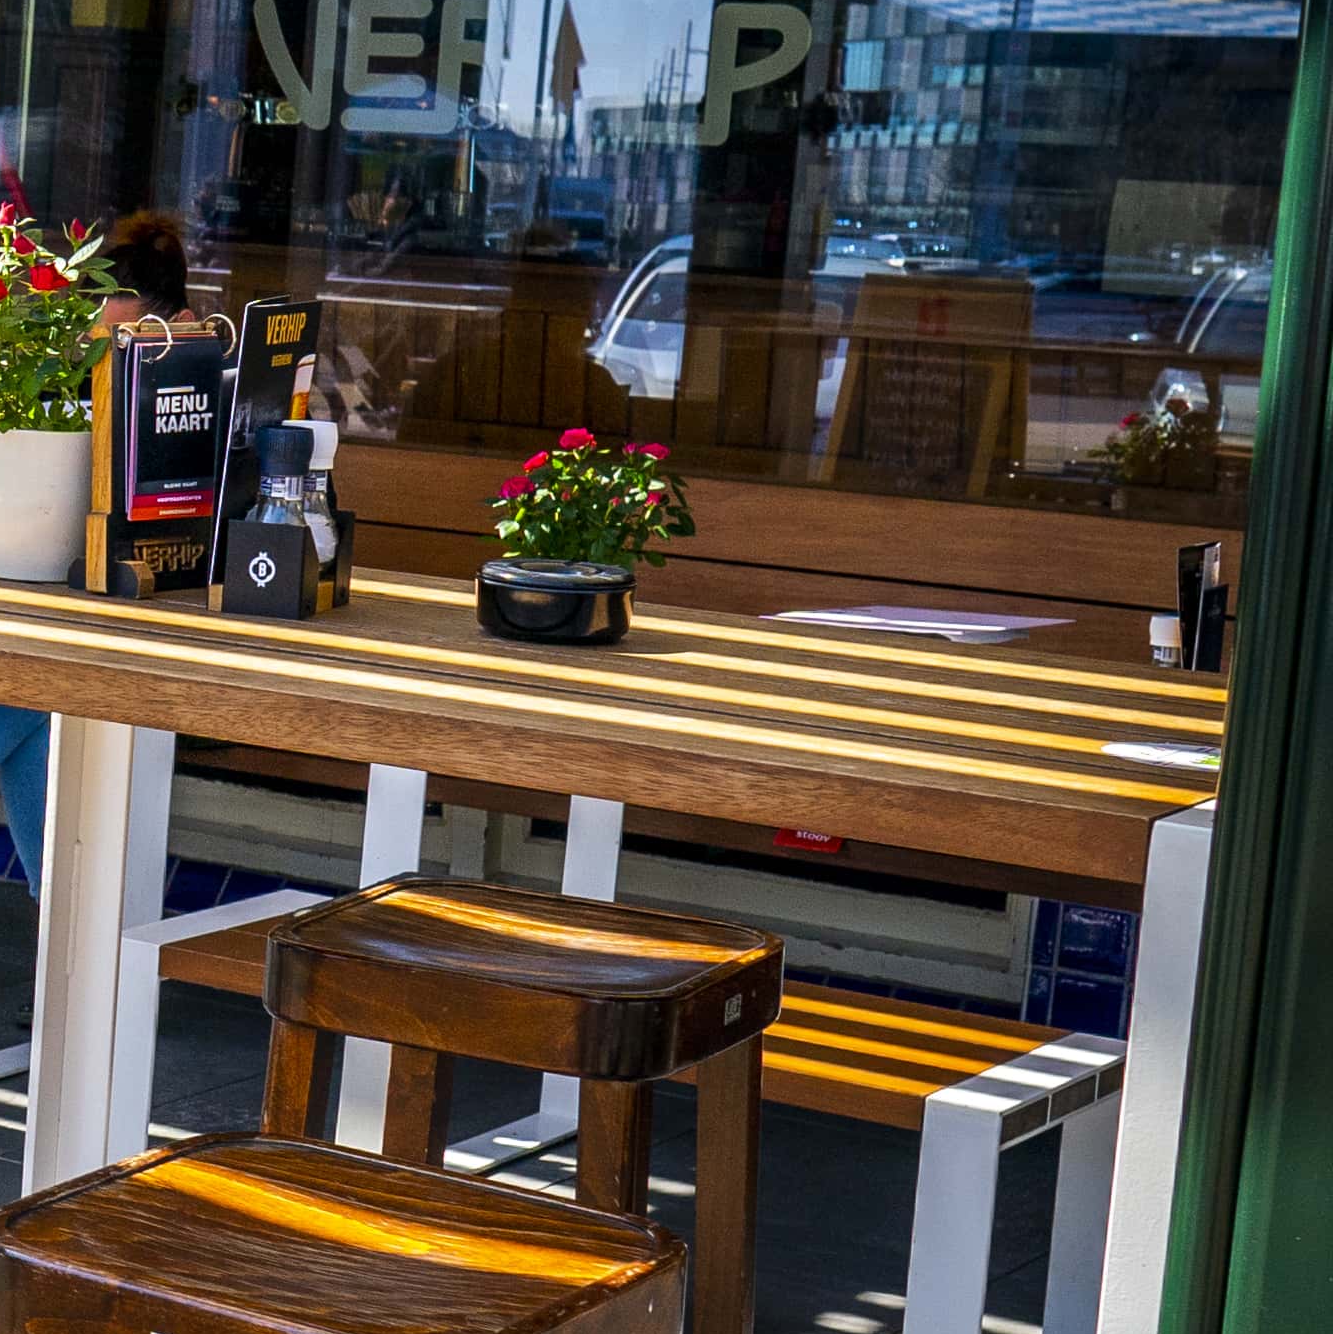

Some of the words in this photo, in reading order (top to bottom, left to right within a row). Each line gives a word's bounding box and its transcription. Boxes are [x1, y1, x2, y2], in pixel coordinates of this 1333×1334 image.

[265, 312, 307, 346] VERHIP
[155, 393, 209, 415] MENU
[155, 413, 213, 434] KAART
